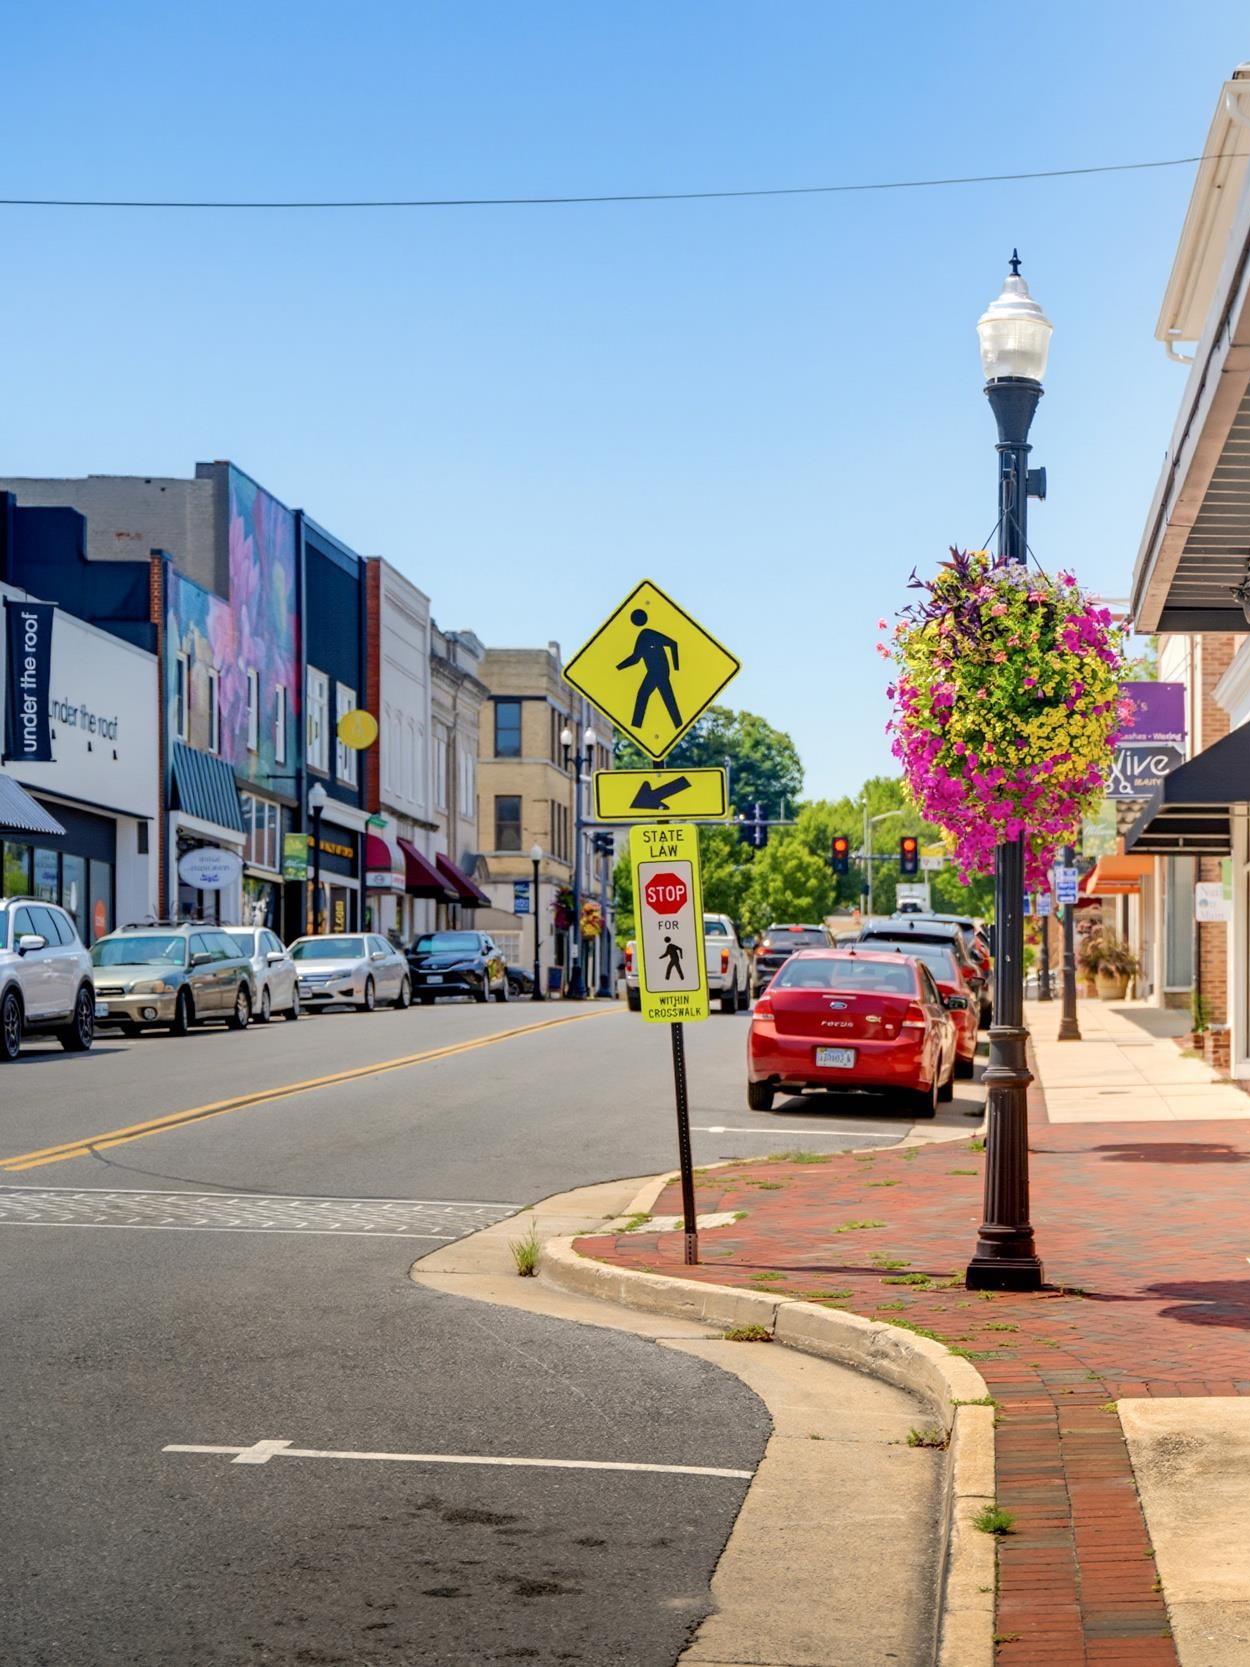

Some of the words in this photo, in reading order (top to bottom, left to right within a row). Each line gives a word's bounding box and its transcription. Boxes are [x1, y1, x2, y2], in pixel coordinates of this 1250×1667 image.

[21, 611, 38, 652] roof
[20, 656, 37, 688] the
[20, 693, 37, 752] under
[642, 829, 685, 843] STATE
[650, 844, 678, 858] LAW
[647, 885, 686, 903] STOP
[658, 920, 680, 930] FOR
[659, 995, 690, 1006] WITHIN
[648, 1007, 702, 1019] CROSSWALK
